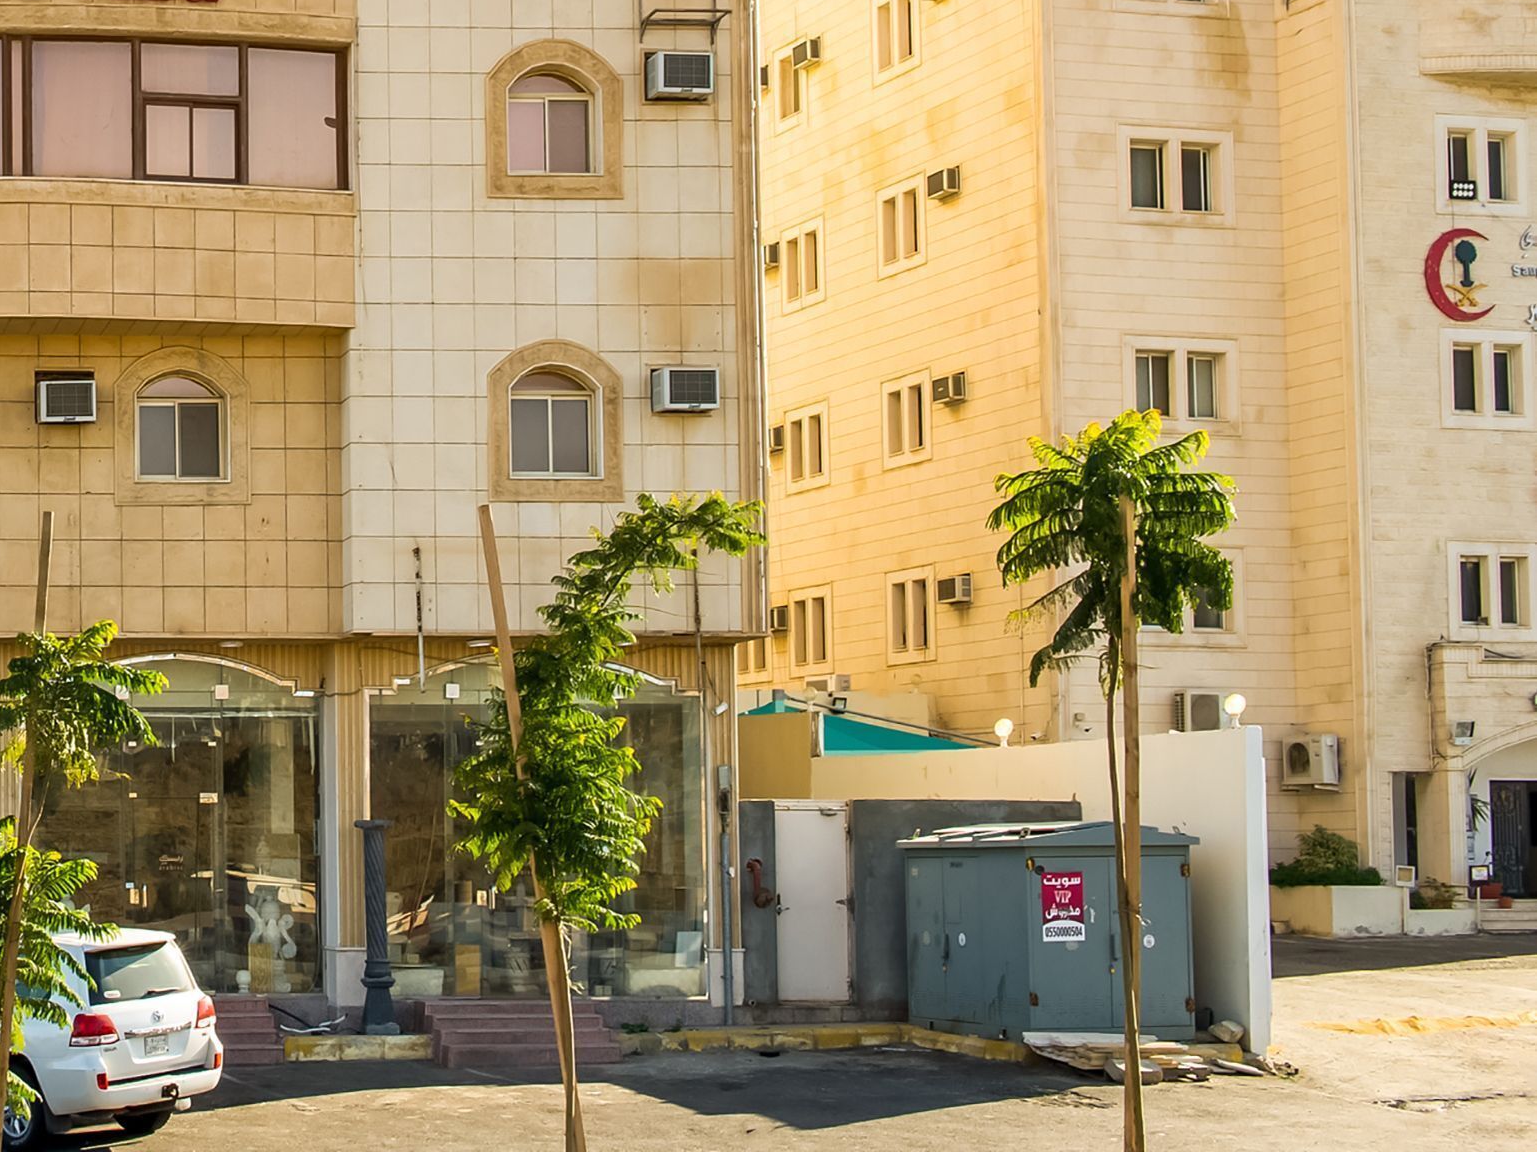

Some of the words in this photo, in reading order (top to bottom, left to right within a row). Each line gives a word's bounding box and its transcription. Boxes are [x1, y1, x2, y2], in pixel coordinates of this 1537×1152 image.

[1512, 264, 1537, 278] Sau
[1043, 875, 1081, 889] سويت
[1054, 890, 1072, 904] VIP
